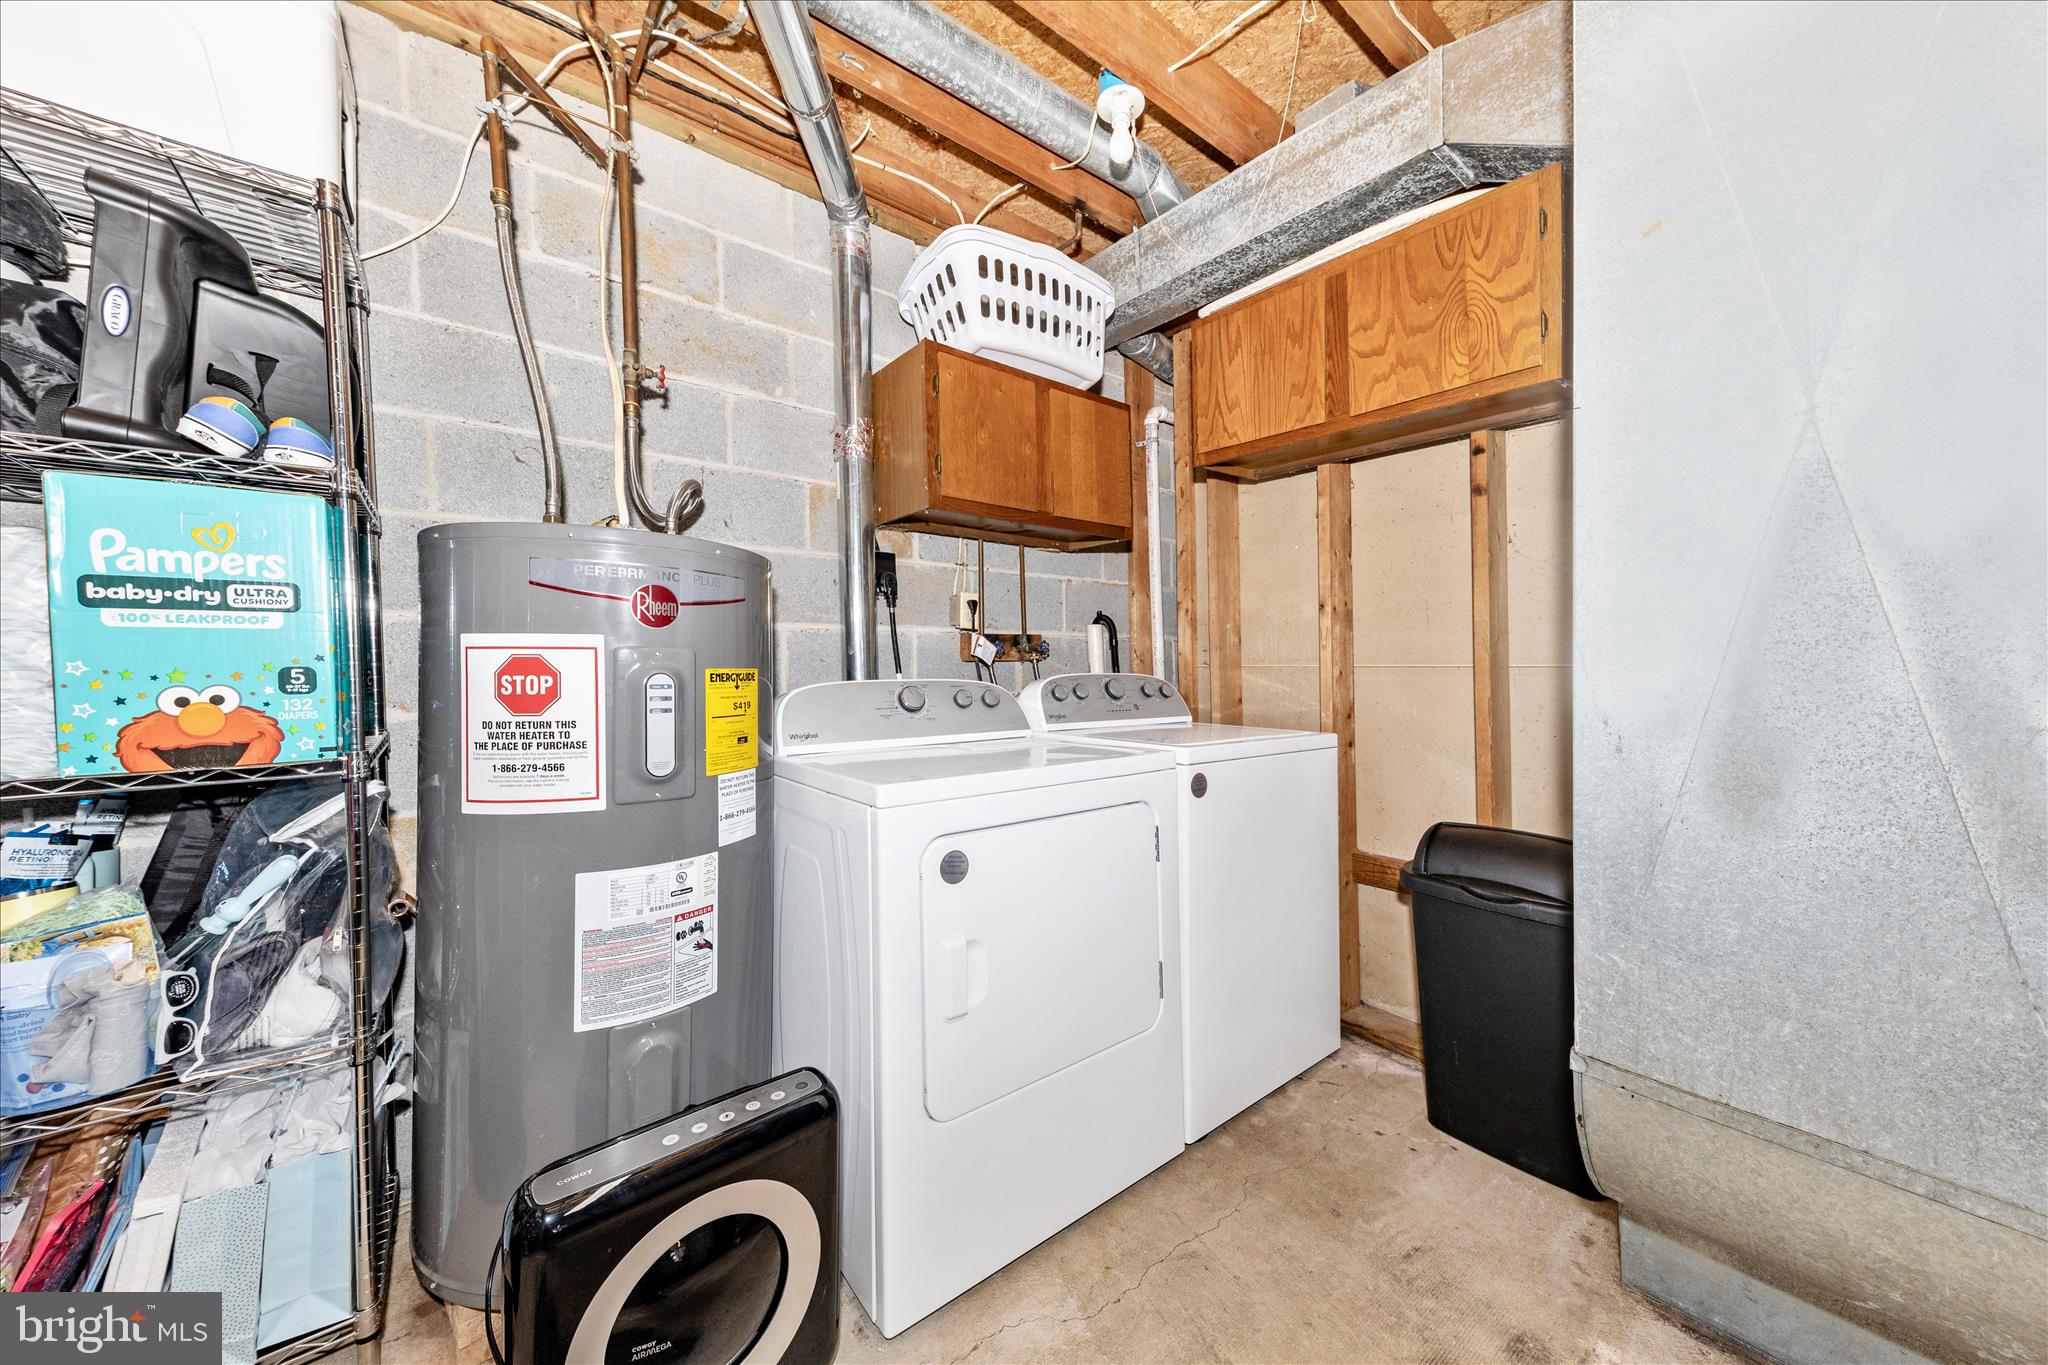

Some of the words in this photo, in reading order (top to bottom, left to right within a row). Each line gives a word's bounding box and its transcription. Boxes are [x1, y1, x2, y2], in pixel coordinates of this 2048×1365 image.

[89, 527, 286, 582] Pampers
[693, 575, 721, 588] PLUS
[234, 587, 287, 599] ULTRA
[232, 597, 289, 606] CUSHIONY
[636, 584, 677, 622] Rheem
[118, 612, 160, 624] 100%
[165, 613, 270, 626] LEAKPROOF
[290, 668, 306, 685] 5
[500, 674, 554, 696] STOP
[282, 697, 314, 711] 132
[279, 711, 319, 720] DIAPERS
[482, 721, 493, 730] DO
[495, 721, 512, 730] NOT
[515, 720, 552, 730] RETURN
[555, 720, 577, 729] THIS
[487, 731, 517, 740] WATER
[519, 731, 555, 740] HEATER
[558, 731, 571, 740] TO
[789, 732, 819, 742] Whirlpool
[474, 742, 489, 751] THE
[491, 741, 519, 751] PLACE
[521, 741, 534, 751] OF
[536, 740, 588, 750] PURCHASE
[492, 763, 565, 773] 1-866-279-4566
[11, 849, 72, 857] HYALURONIC
[684, 906, 712, 919] DANGER
[7, 1010, 31, 1020] baby
[556, 1168, 593, 1186] coway
[632, 1340, 657, 1353] coway
[632, 1341, 672, 1361] AIRMEGA
